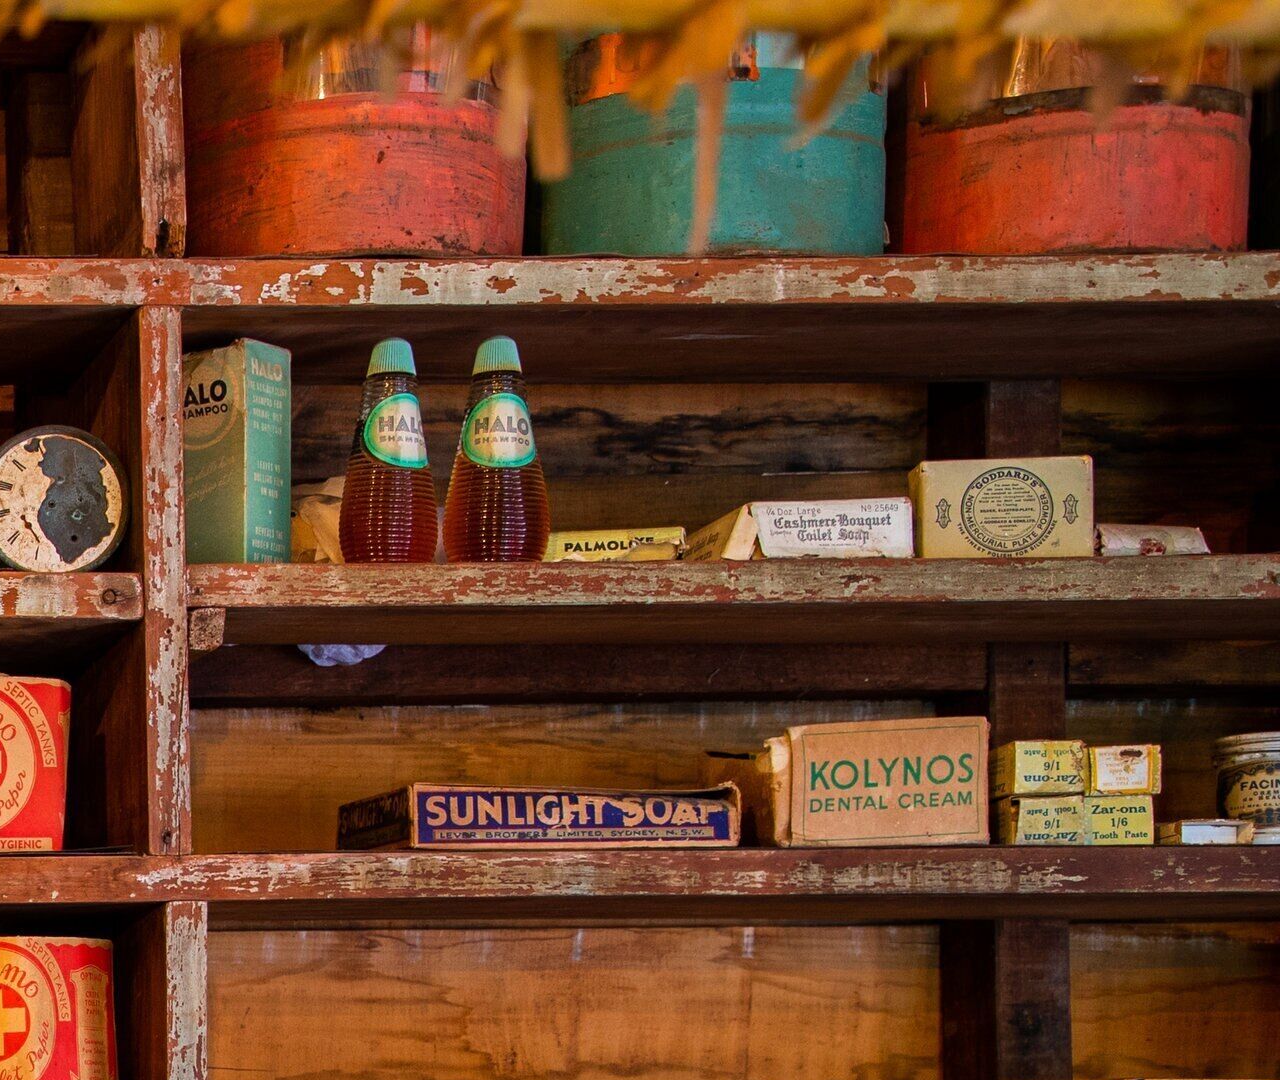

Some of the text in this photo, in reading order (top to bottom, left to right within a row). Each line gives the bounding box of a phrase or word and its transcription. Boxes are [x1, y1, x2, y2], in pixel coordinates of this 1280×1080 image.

[251, 357, 283, 382] HALO
[182, 379, 228, 409] ALO
[474, 416, 529, 435] HALO
[474, 436, 530, 447] SHAMPOO
[797, 507, 821, 518] Large
[774, 513, 892, 530] Cashmere Bouquet
[797, 529, 832, 542] Toilet
[1012, 531, 1039, 548] PLATE
[965, 536, 985, 553] FINEST
[1015, 549, 1028, 557] FOR
[4, 681, 56, 767] SEPTIC TANKS
[809, 752, 975, 791] KOLYNOS
[1024, 774, 1079, 785] Zar-ona
[425, 794, 604, 827] SUNLIGHT
[620, 796, 724, 827] SOAP
[809, 790, 973, 814] DENTAL CREAM
[1054, 806, 1078, 815] Tooth
[1091, 804, 1147, 815] Zar-ona
[1110, 817, 1128, 828] 1/6
[1024, 831, 1078, 842] Zar-ona
[1092, 830, 1148, 840] Tooth Paste
[25, 937, 71, 1020] SEPTIC TANKS
